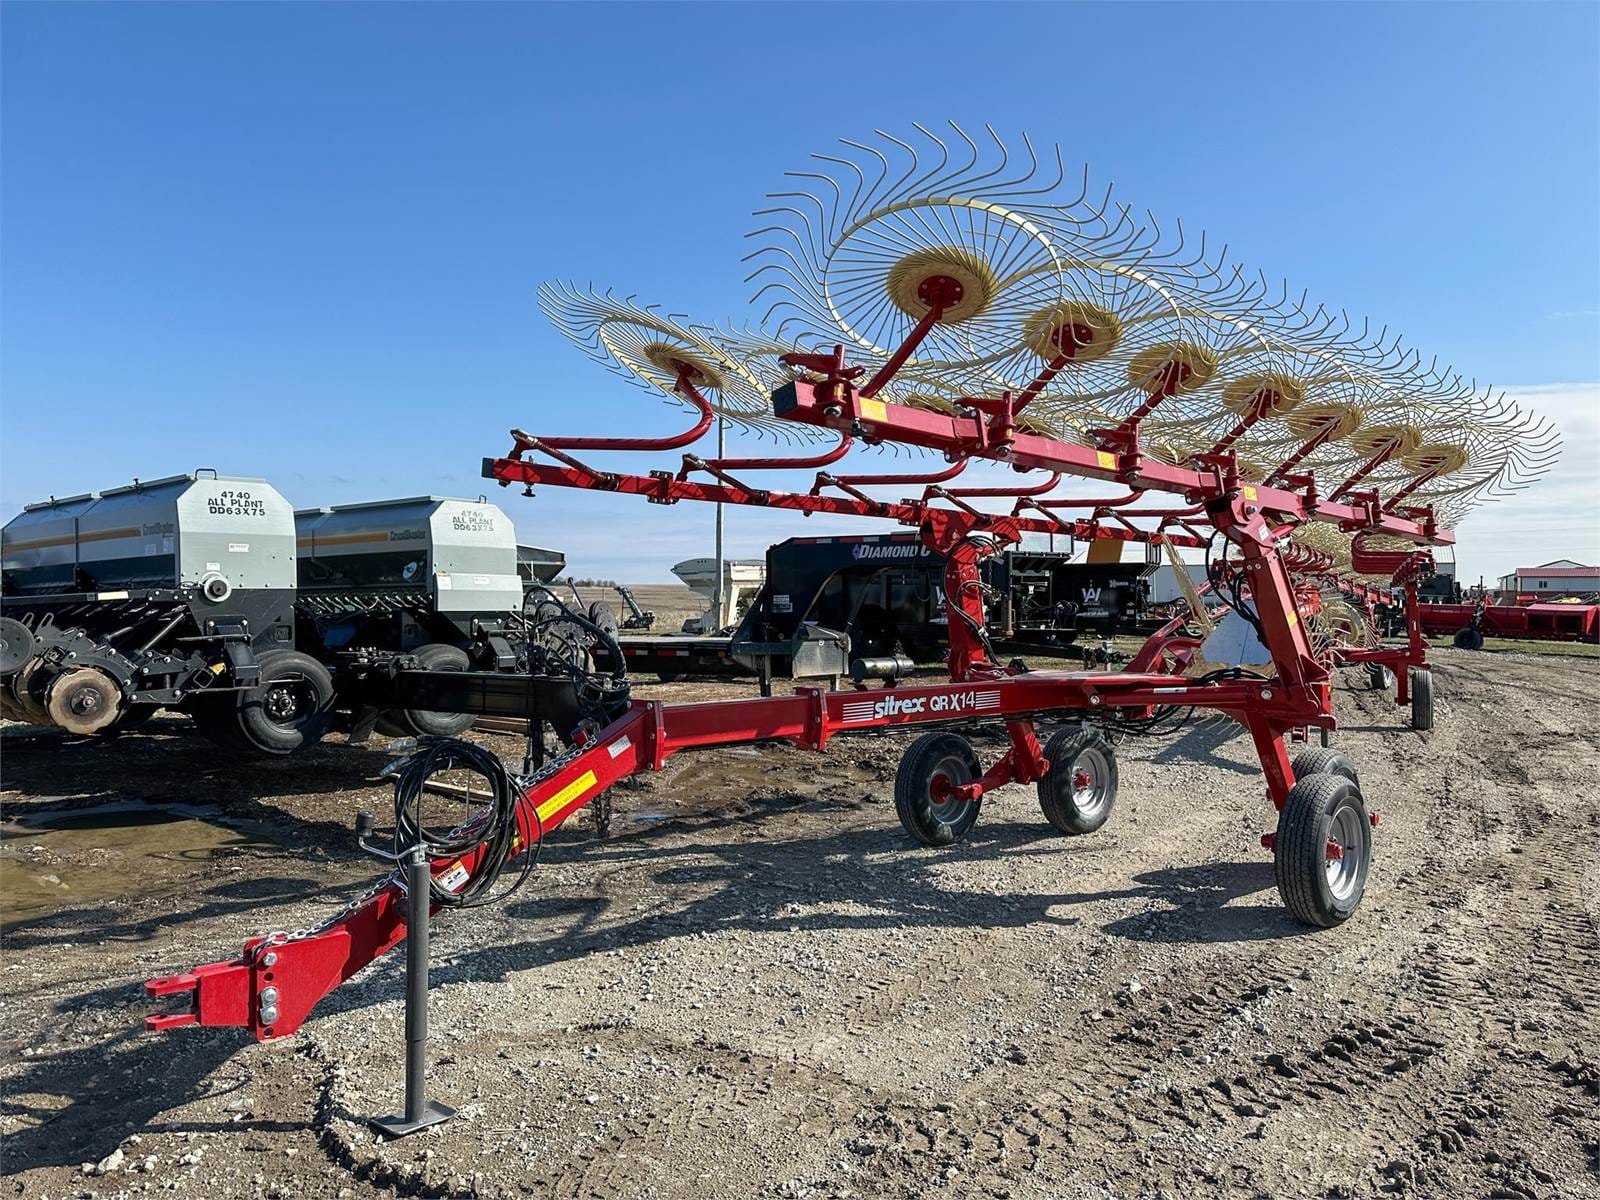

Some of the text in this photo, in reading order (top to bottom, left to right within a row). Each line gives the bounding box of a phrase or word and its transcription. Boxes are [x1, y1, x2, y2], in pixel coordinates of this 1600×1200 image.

[221, 491, 251, 499] 4740
[207, 498, 263, 508] ALL PLANT
[209, 507, 265, 516] DD63X75
[452, 516, 494, 526] ALL PLANT
[858, 544, 919, 559] DIAMOND
[874, 696, 927, 719] sitrex
